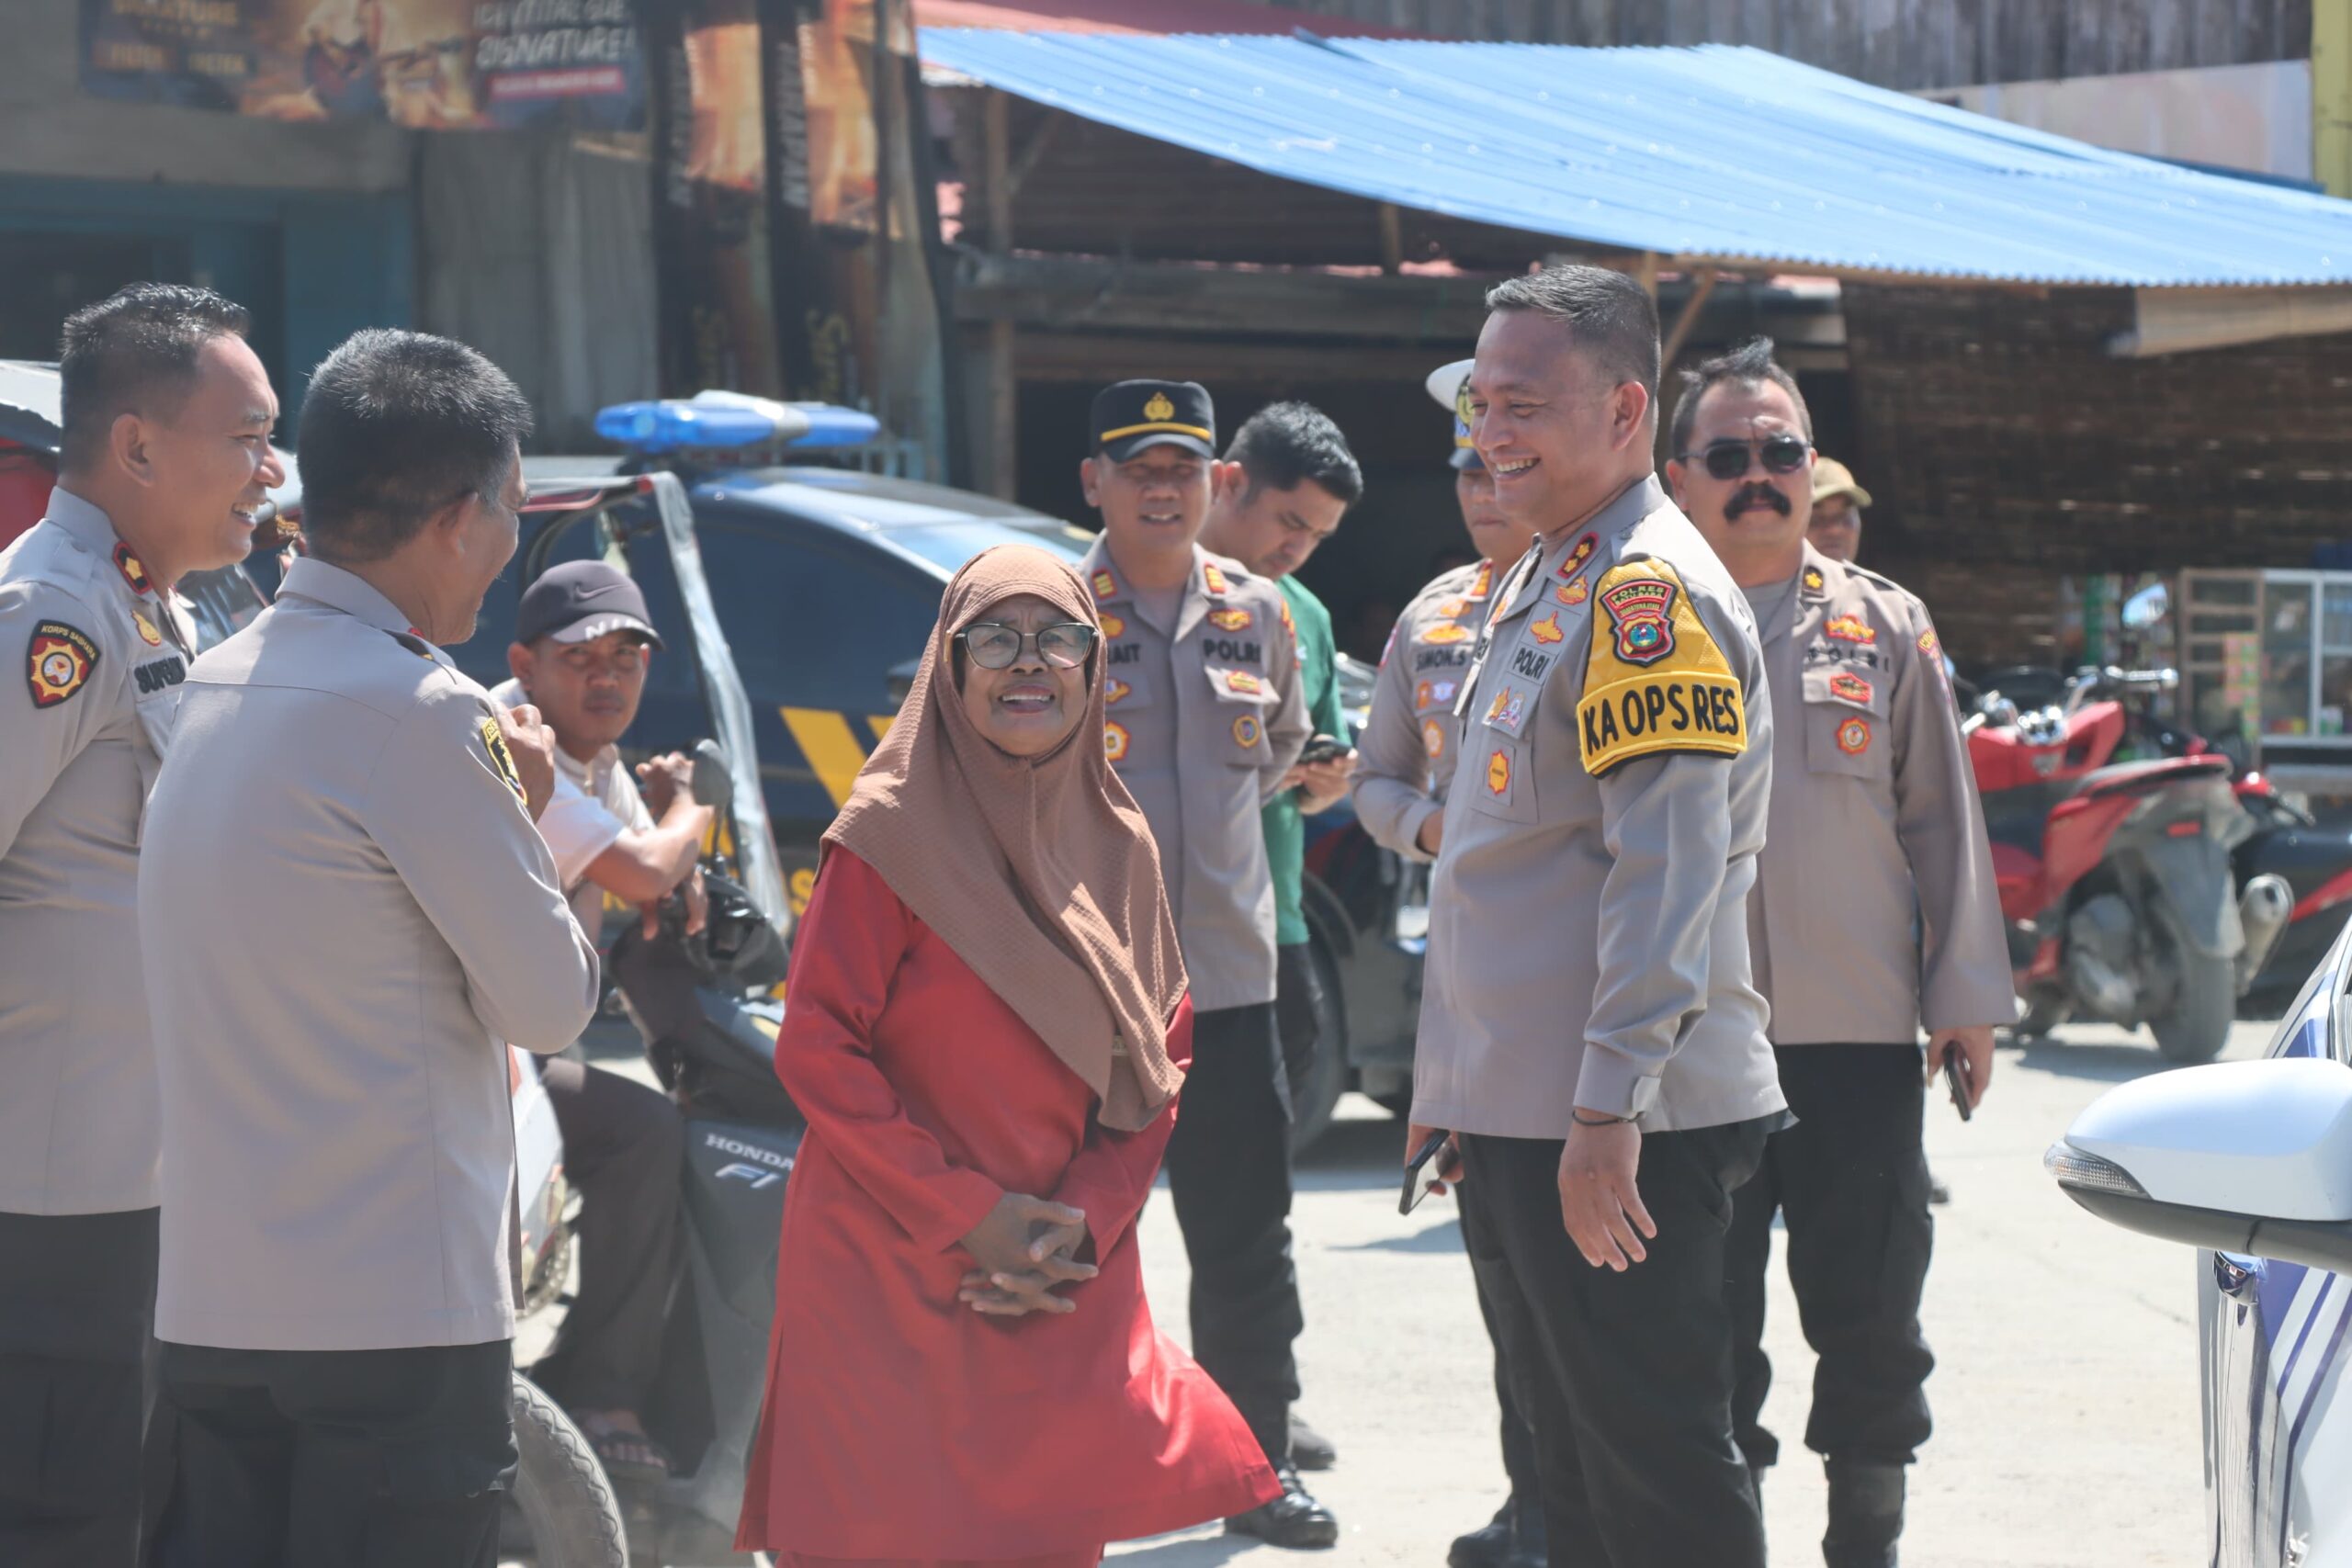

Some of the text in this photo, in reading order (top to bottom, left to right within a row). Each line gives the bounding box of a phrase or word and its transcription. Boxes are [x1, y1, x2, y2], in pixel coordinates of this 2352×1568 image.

[1611, 586, 1664, 602] POLRES
[41, 625, 69, 636] KORPS
[1203, 639, 1261, 663] POLRI
[1513, 647, 1550, 680] POLRI
